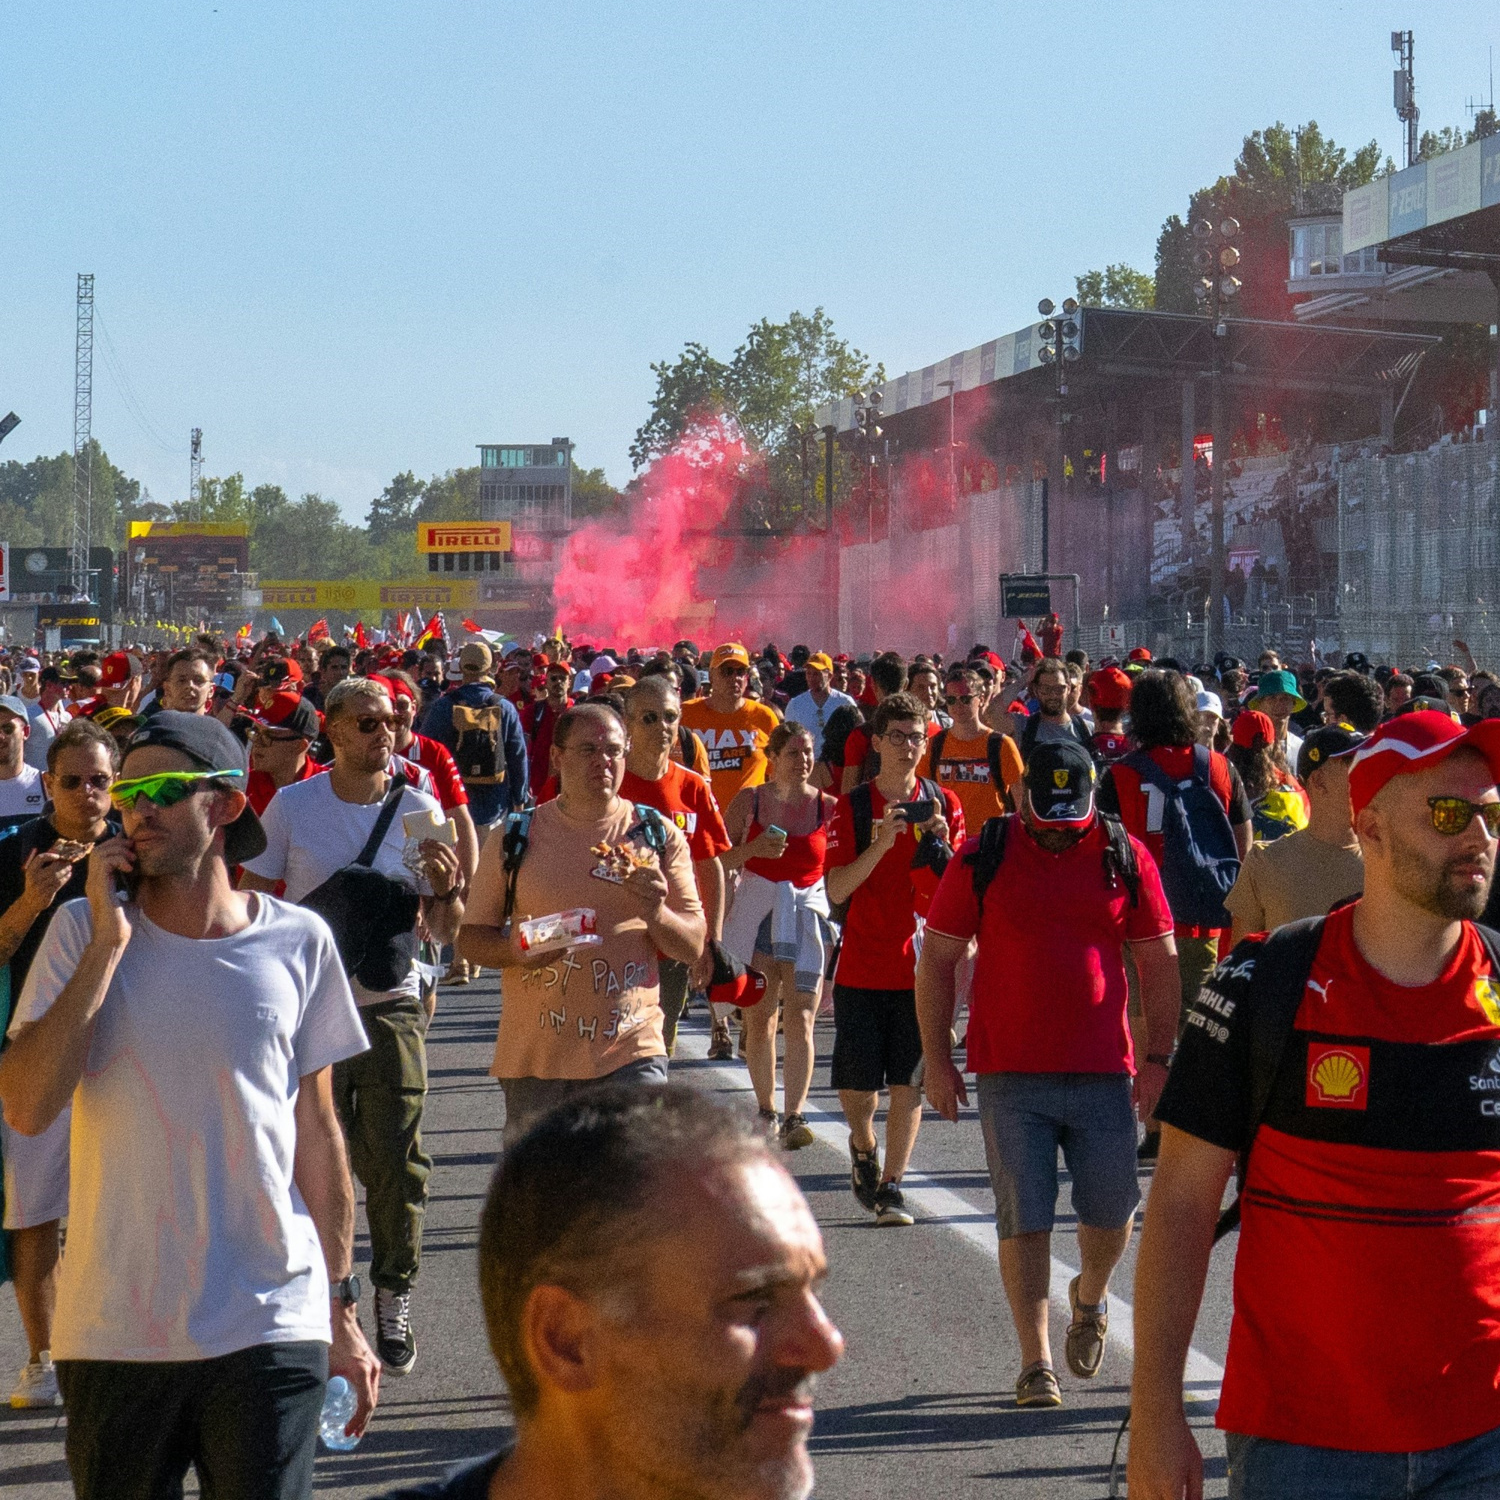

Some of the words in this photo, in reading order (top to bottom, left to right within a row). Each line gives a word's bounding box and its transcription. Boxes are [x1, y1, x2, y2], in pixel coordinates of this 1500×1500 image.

[428, 528, 501, 547] PIRELLI
[693, 728, 756, 751] MAX
[710, 757, 741, 770] BACK
